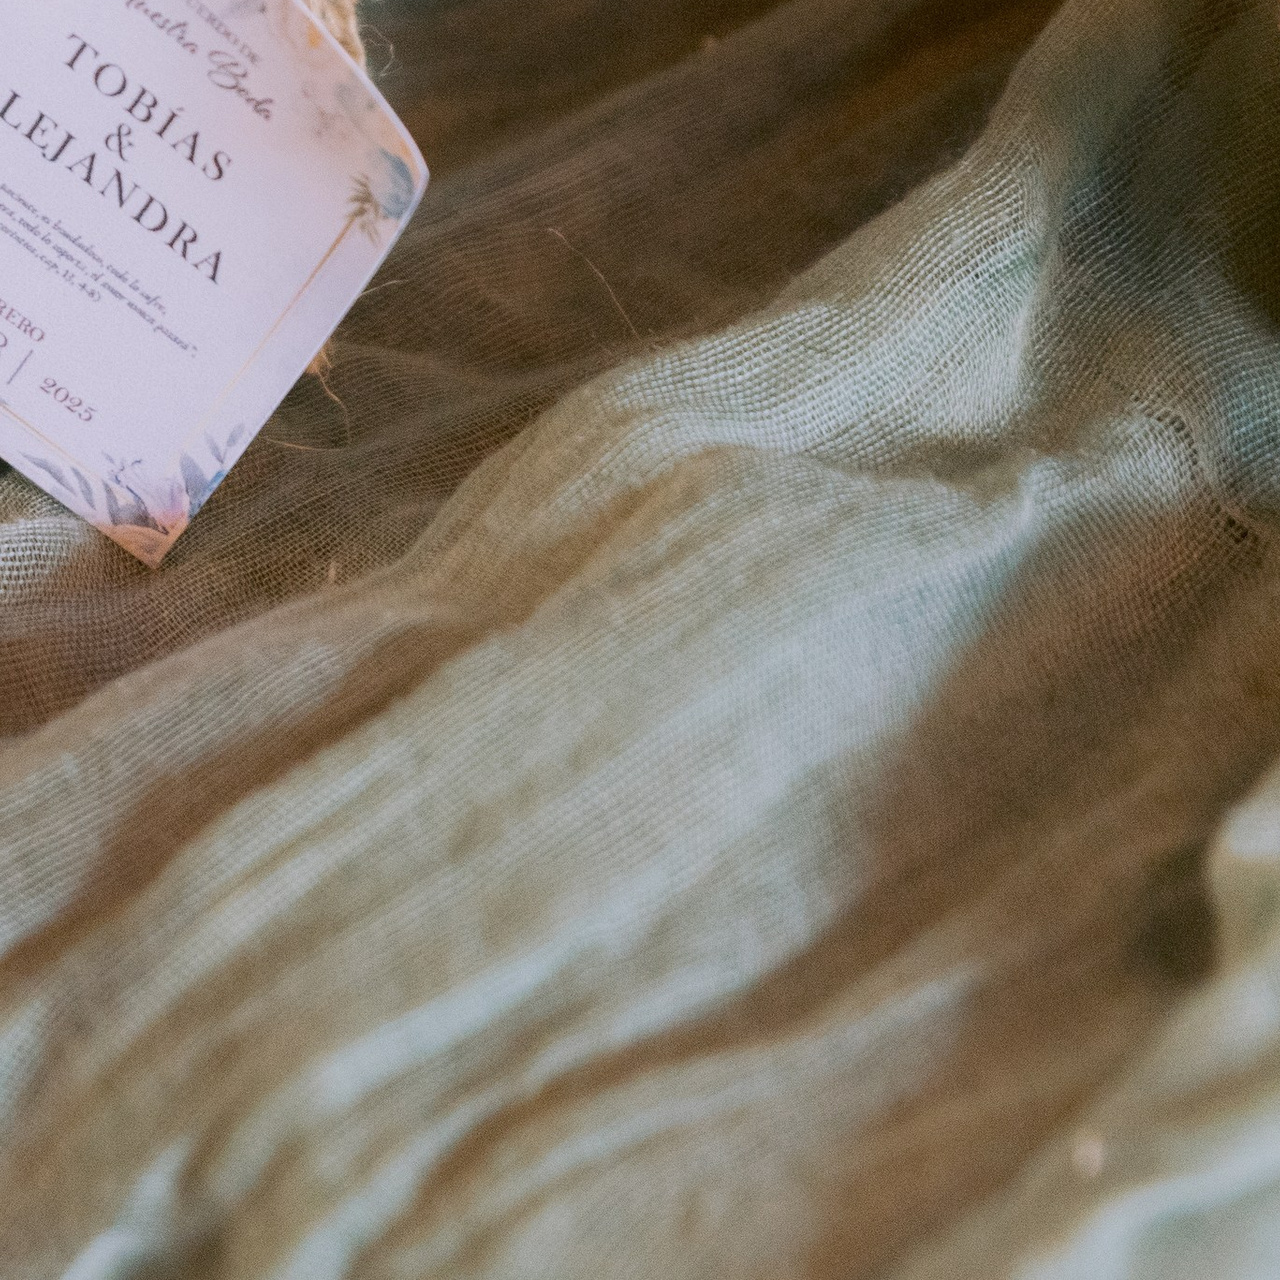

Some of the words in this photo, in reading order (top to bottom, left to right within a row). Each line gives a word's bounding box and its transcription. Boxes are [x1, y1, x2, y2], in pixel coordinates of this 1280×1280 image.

[65, 33, 232, 181] TOBÍAS
[103, 123, 134, 162] &
[39, 377, 97, 423] 2025
